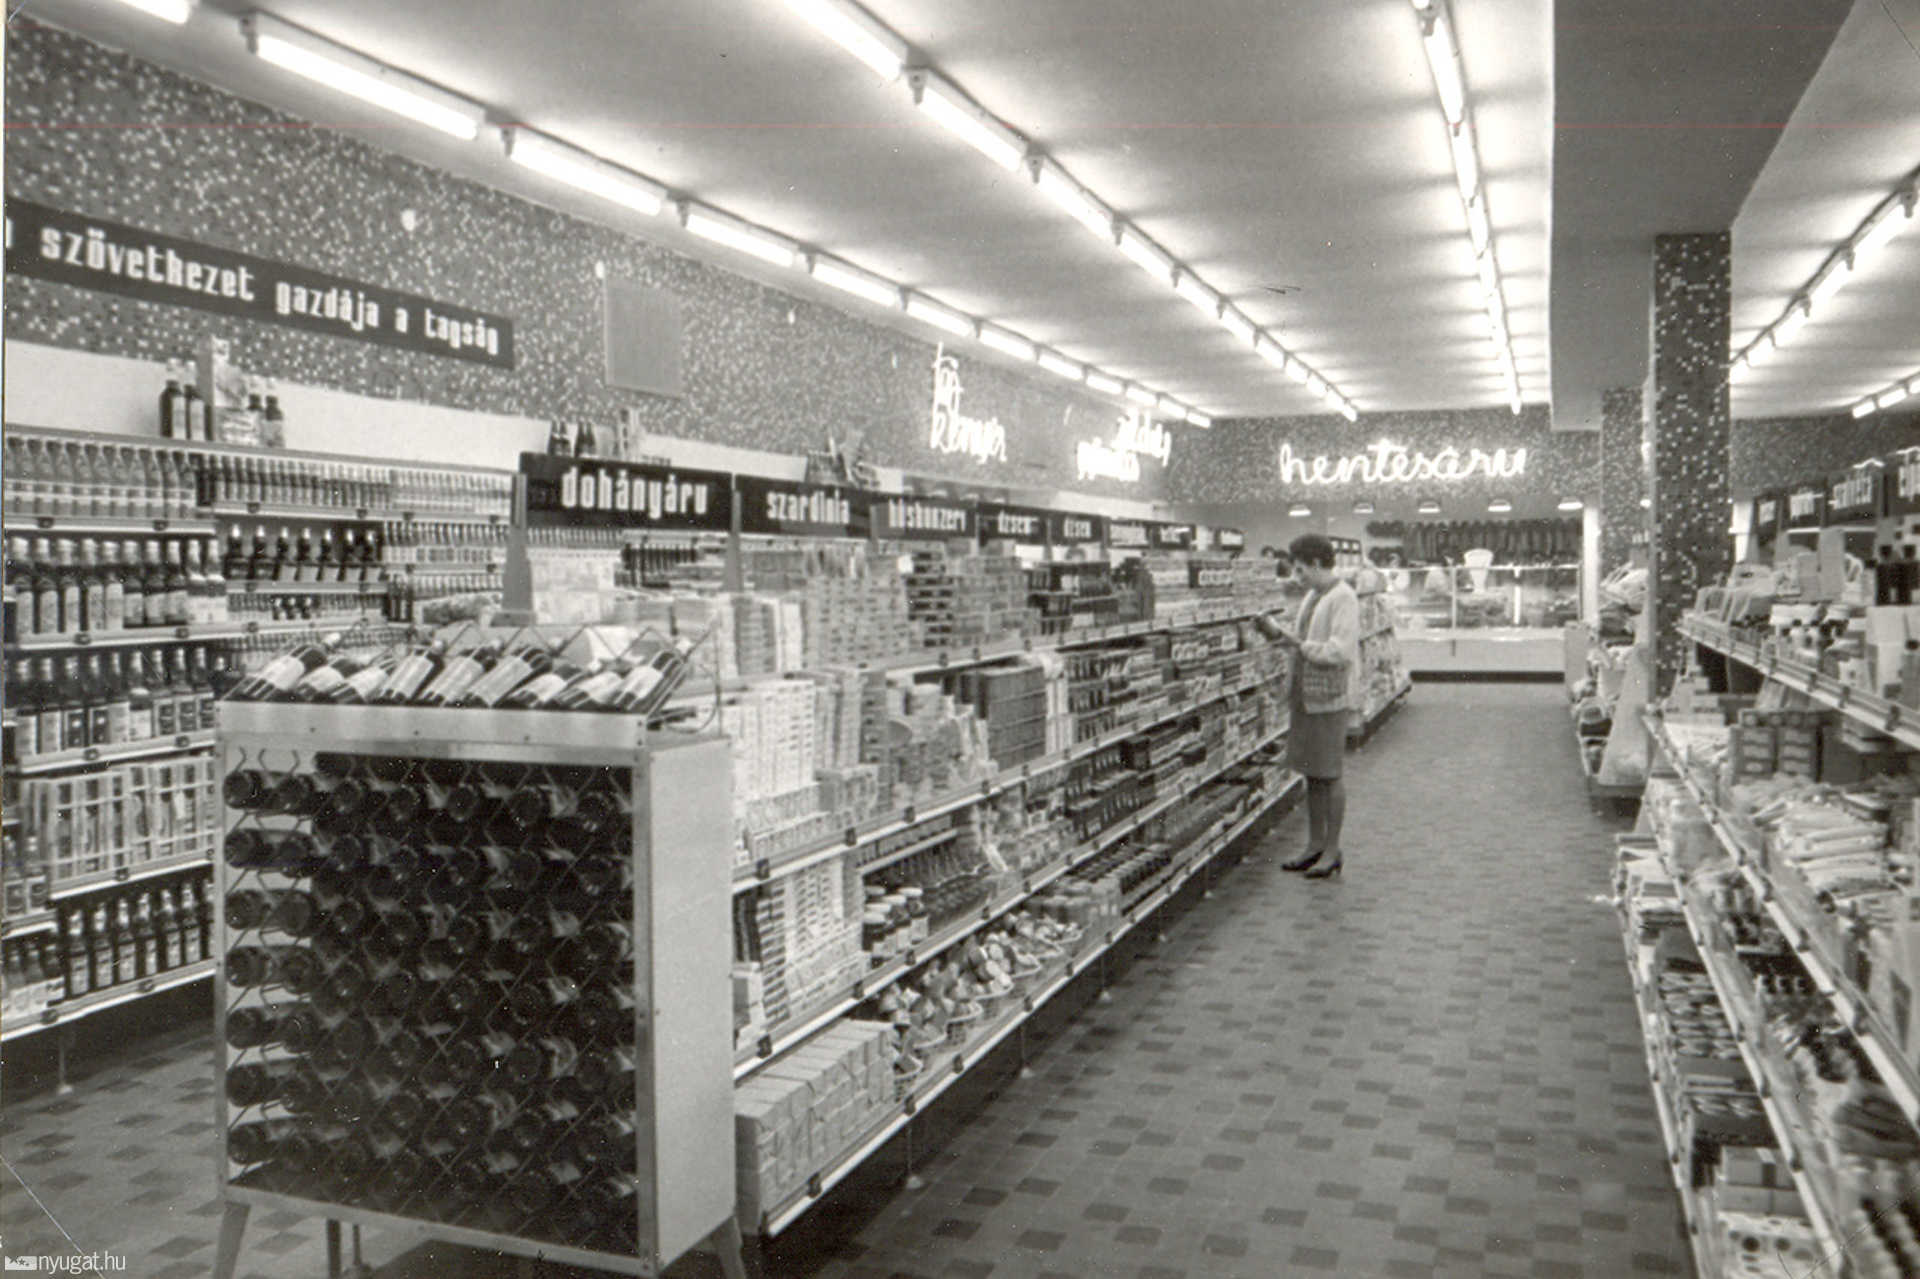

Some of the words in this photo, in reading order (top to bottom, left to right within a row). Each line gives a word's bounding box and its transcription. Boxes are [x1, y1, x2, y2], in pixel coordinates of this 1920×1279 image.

[40, 226, 256, 302] szövetkezet
[275, 281, 380, 332] gazdája
[395, 307, 408, 333] a
[424, 307, 498, 356] tagság
[1279, 441, 1528, 486] hentesáru
[561, 466, 708, 520] dohányáru
